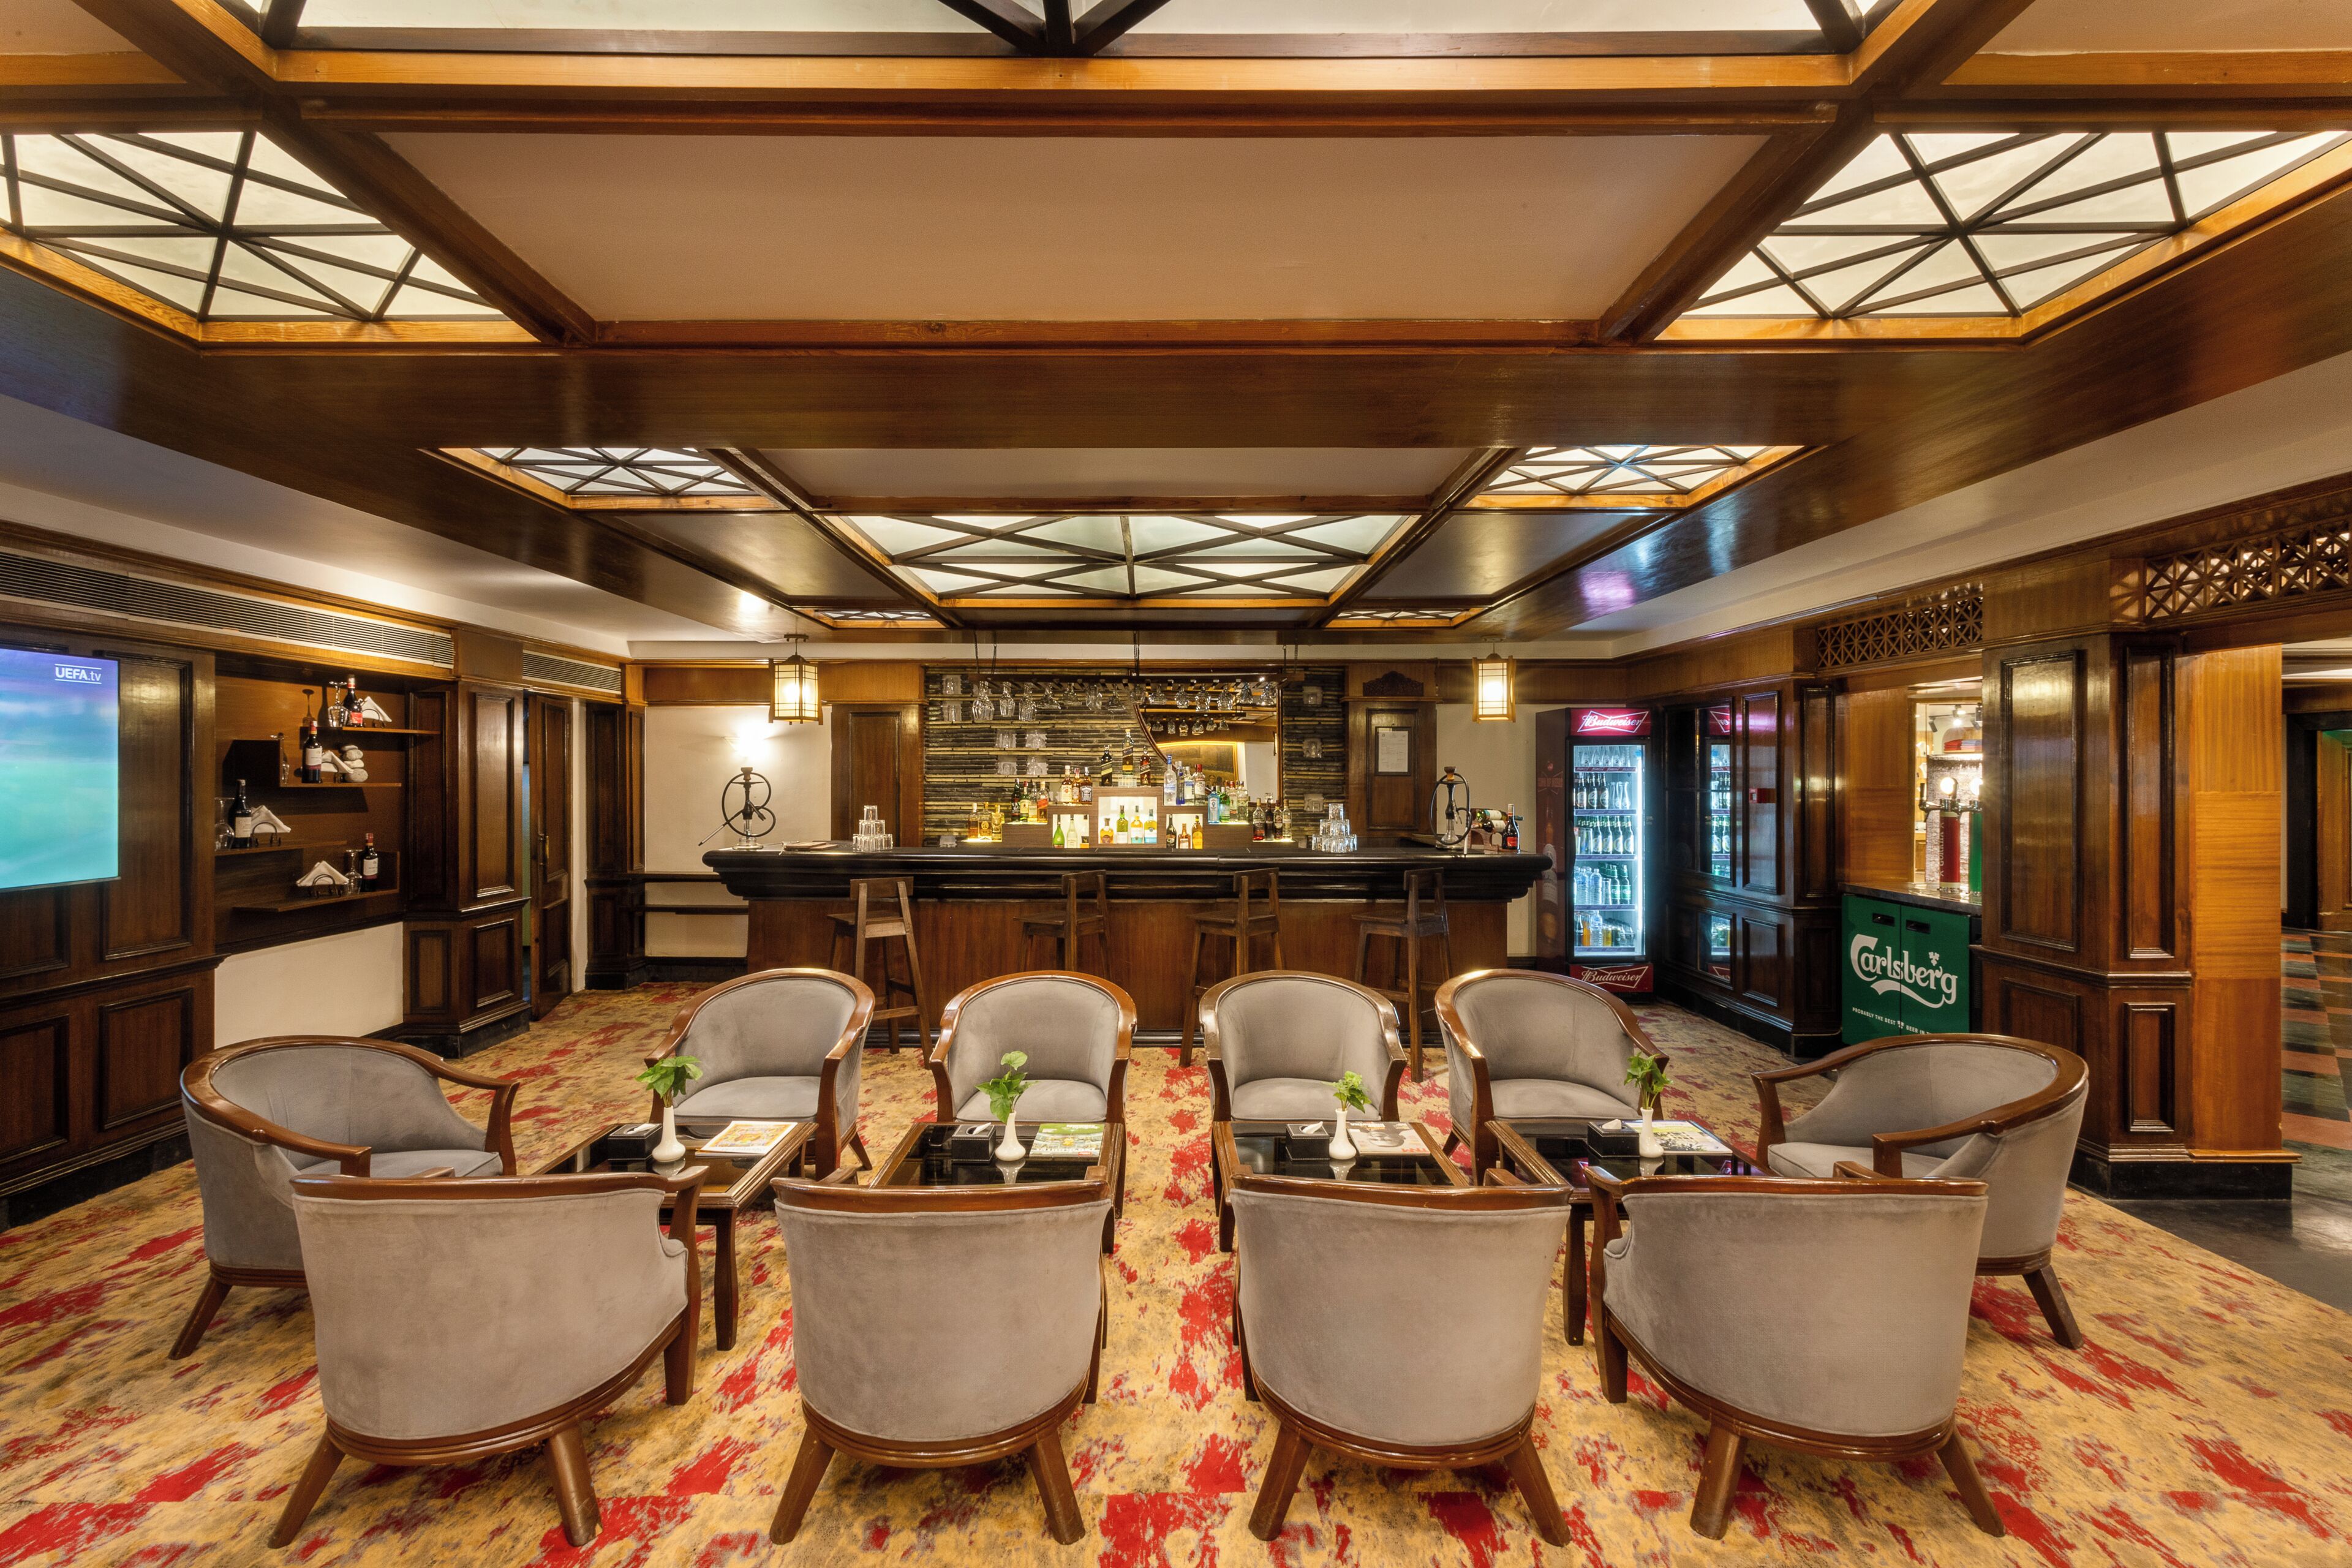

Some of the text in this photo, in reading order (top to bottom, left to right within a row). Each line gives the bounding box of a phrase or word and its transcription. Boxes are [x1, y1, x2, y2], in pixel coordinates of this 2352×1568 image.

[55, 666, 102, 681] UEFA.tv
[1582, 715, 1642, 727] Budweiser
[1581, 969, 1642, 982] Budweiser
[1850, 933, 1958, 1008] Carlsberg
[1852, 1007, 1874, 1019] PROBABLY
[1885, 1017, 1896, 1026] BEST
[1906, 1025, 1918, 1033] BEER
